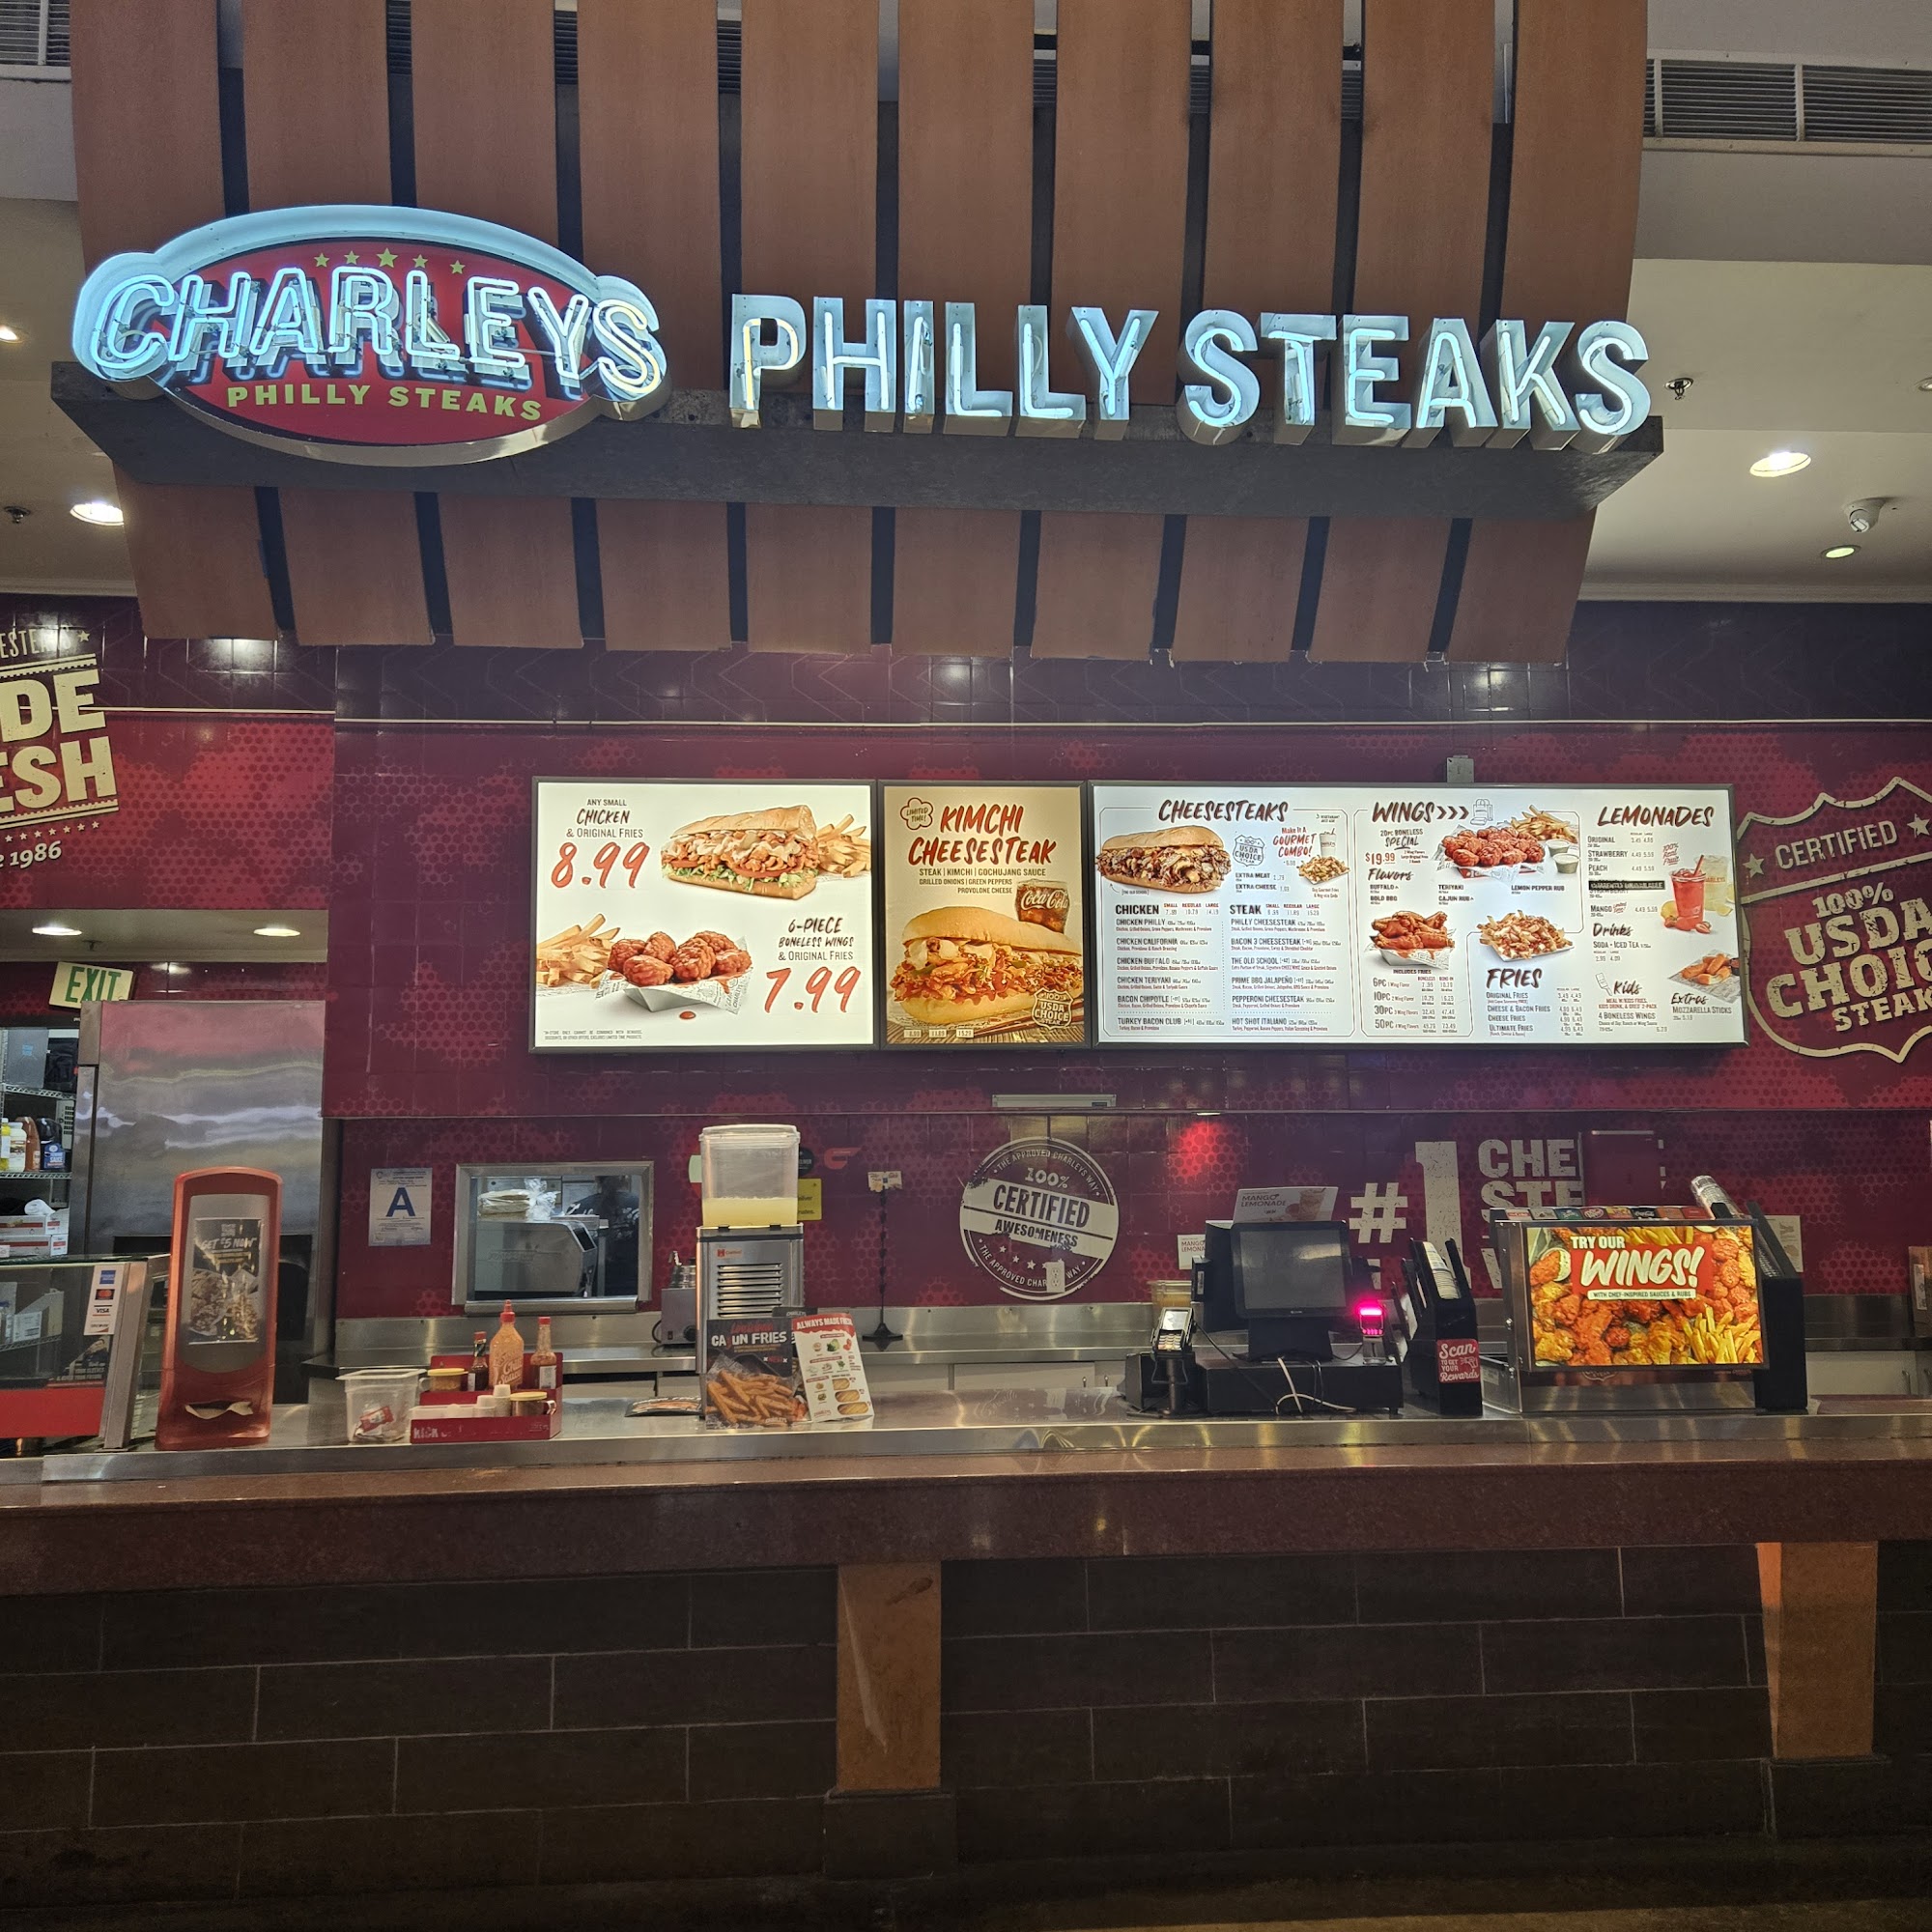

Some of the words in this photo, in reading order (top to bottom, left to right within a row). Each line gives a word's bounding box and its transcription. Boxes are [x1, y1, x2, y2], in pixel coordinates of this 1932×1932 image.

[87, 266, 665, 403] CHARLEYS
[730, 294, 1159, 436] PHILLY
[1179, 309, 1652, 453] STEAKS
[228, 384, 371, 408] PHILLY
[388, 386, 542, 421] STEAKS
[576, 809, 630, 826] CHICKEN
[1158, 800, 1289, 823] CHEESESTEAKS
[1373, 802, 1435, 823] WINGS
[1597, 805, 1714, 827] LEMONADES
[940, 804, 1024, 837] KIMCHI
[567, 829, 575, 838] &
[577, 828, 616, 838] ORIGINAL
[619, 828, 643, 838] FRIES
[1273, 834, 1317, 845] GOURMET
[1385, 837, 1418, 847] SPECIAL
[1775, 820, 1897, 869] CERTIFIED
[10, 840, 62, 868] 1986
[908, 837, 1056, 866] CHEESESTEAK
[1235, 851, 1262, 861] CHOICE
[1278, 846, 1312, 857] COMBO!
[1365, 852, 1395, 865] $19.99
[551, 842, 650, 889] 8.99
[1368, 867, 1413, 880] Flavors
[1230, 904, 1262, 914] STEAK
[1812, 882, 1894, 919] 100%
[1116, 905, 1159, 914] CHICKEN
[788, 918, 842, 933] 6-PIECE
[1593, 923, 1634, 937] Drinks
[1784, 897, 1932, 965] USDA
[779, 937, 822, 948] BONELESS
[825, 937, 854, 948] WINGS
[788, 952, 827, 960] ORIGINAL
[830, 952, 853, 960] FRIES
[65, 965, 122, 1003] EXIT
[1373, 978, 1386, 987] 6PC
[1487, 968, 1543, 989] FRIES
[765, 966, 862, 1013] 7.99
[1374, 991, 1390, 1001] 10PC
[1613, 980, 1642, 995] Kids
[1040, 1002, 1065, 1012] USDA
[1671, 992, 1709, 1006] Extras
[1034, 1010, 1068, 1021] CHOICE
[1375, 1006, 1393, 1014] 30PC
[1833, 987, 1932, 1032] STEAK
[1375, 1019, 1393, 1029] 50PC
[1478, 1139, 1577, 1178] CHE
[997, 1159, 1011, 1171] THE
[1012, 1150, 1051, 1161] APPROVED
[1053, 1151, 1088, 1177] CHARLEYS
[1086, 1176, 1098, 1191] WAY
[1025, 1167, 1072, 1189] 100%
[385, 1187, 415, 1216] A
[993, 1184, 1090, 1228] CERTIFIED
[995, 1219, 1078, 1248] AWESOMENESS
[201, 1238, 219, 1250] GET
[1570, 1236, 1597, 1249] TRY
[1598, 1236, 1625, 1249] OUR
[979, 1244, 992, 1261] THE
[989, 1259, 1025, 1285] APPROVED
[1065, 1265, 1081, 1279] WAY
[1579, 1246, 1705, 1288] WINGS!
[797, 1319, 823, 1330] ALWAYS
[823, 1318, 839, 1326] MADE
[711, 1333, 748, 1350] CAJUN
[752, 1331, 786, 1344] FRIES
[1439, 1343, 1476, 1359] Scan
[1439, 1369, 1479, 1381] Rewards
